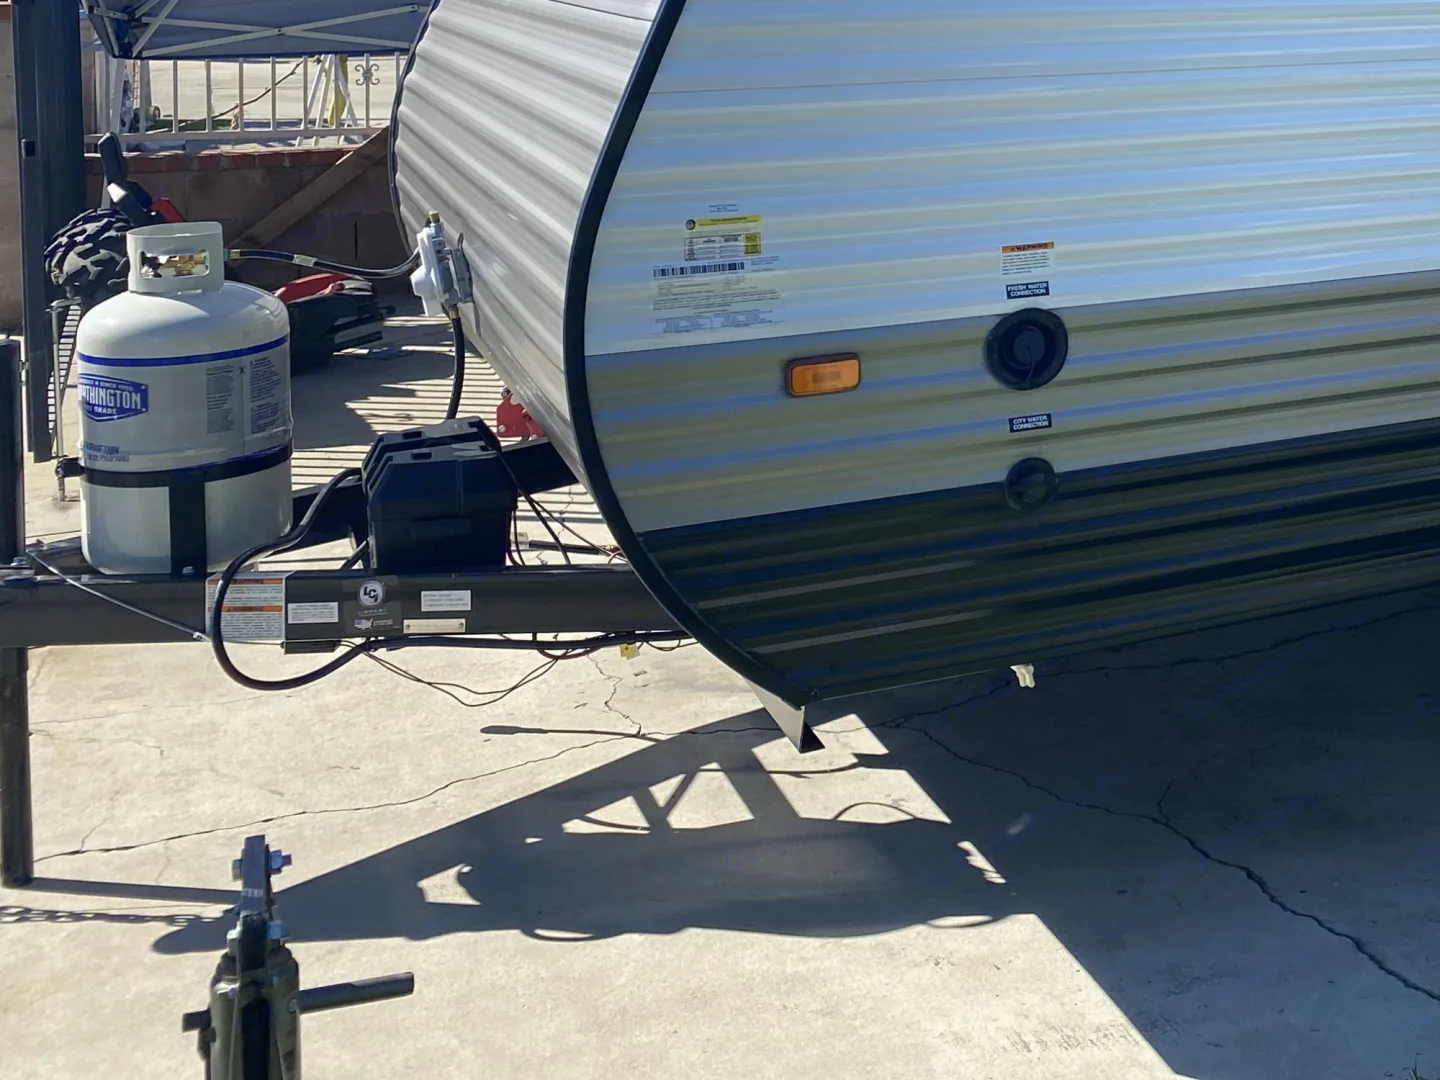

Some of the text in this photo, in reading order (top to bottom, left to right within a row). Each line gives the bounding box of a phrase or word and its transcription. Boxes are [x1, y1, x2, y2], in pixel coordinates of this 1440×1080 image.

[1007, 282, 1048, 292] FRESH WATER
[1010, 288, 1046, 297] CONNECTION
[81, 383, 142, 410] THINGTON
[93, 406, 117, 415] GRADE
[1027, 415, 1048, 423] WATER
[1013, 421, 1049, 431] CONNECTION
